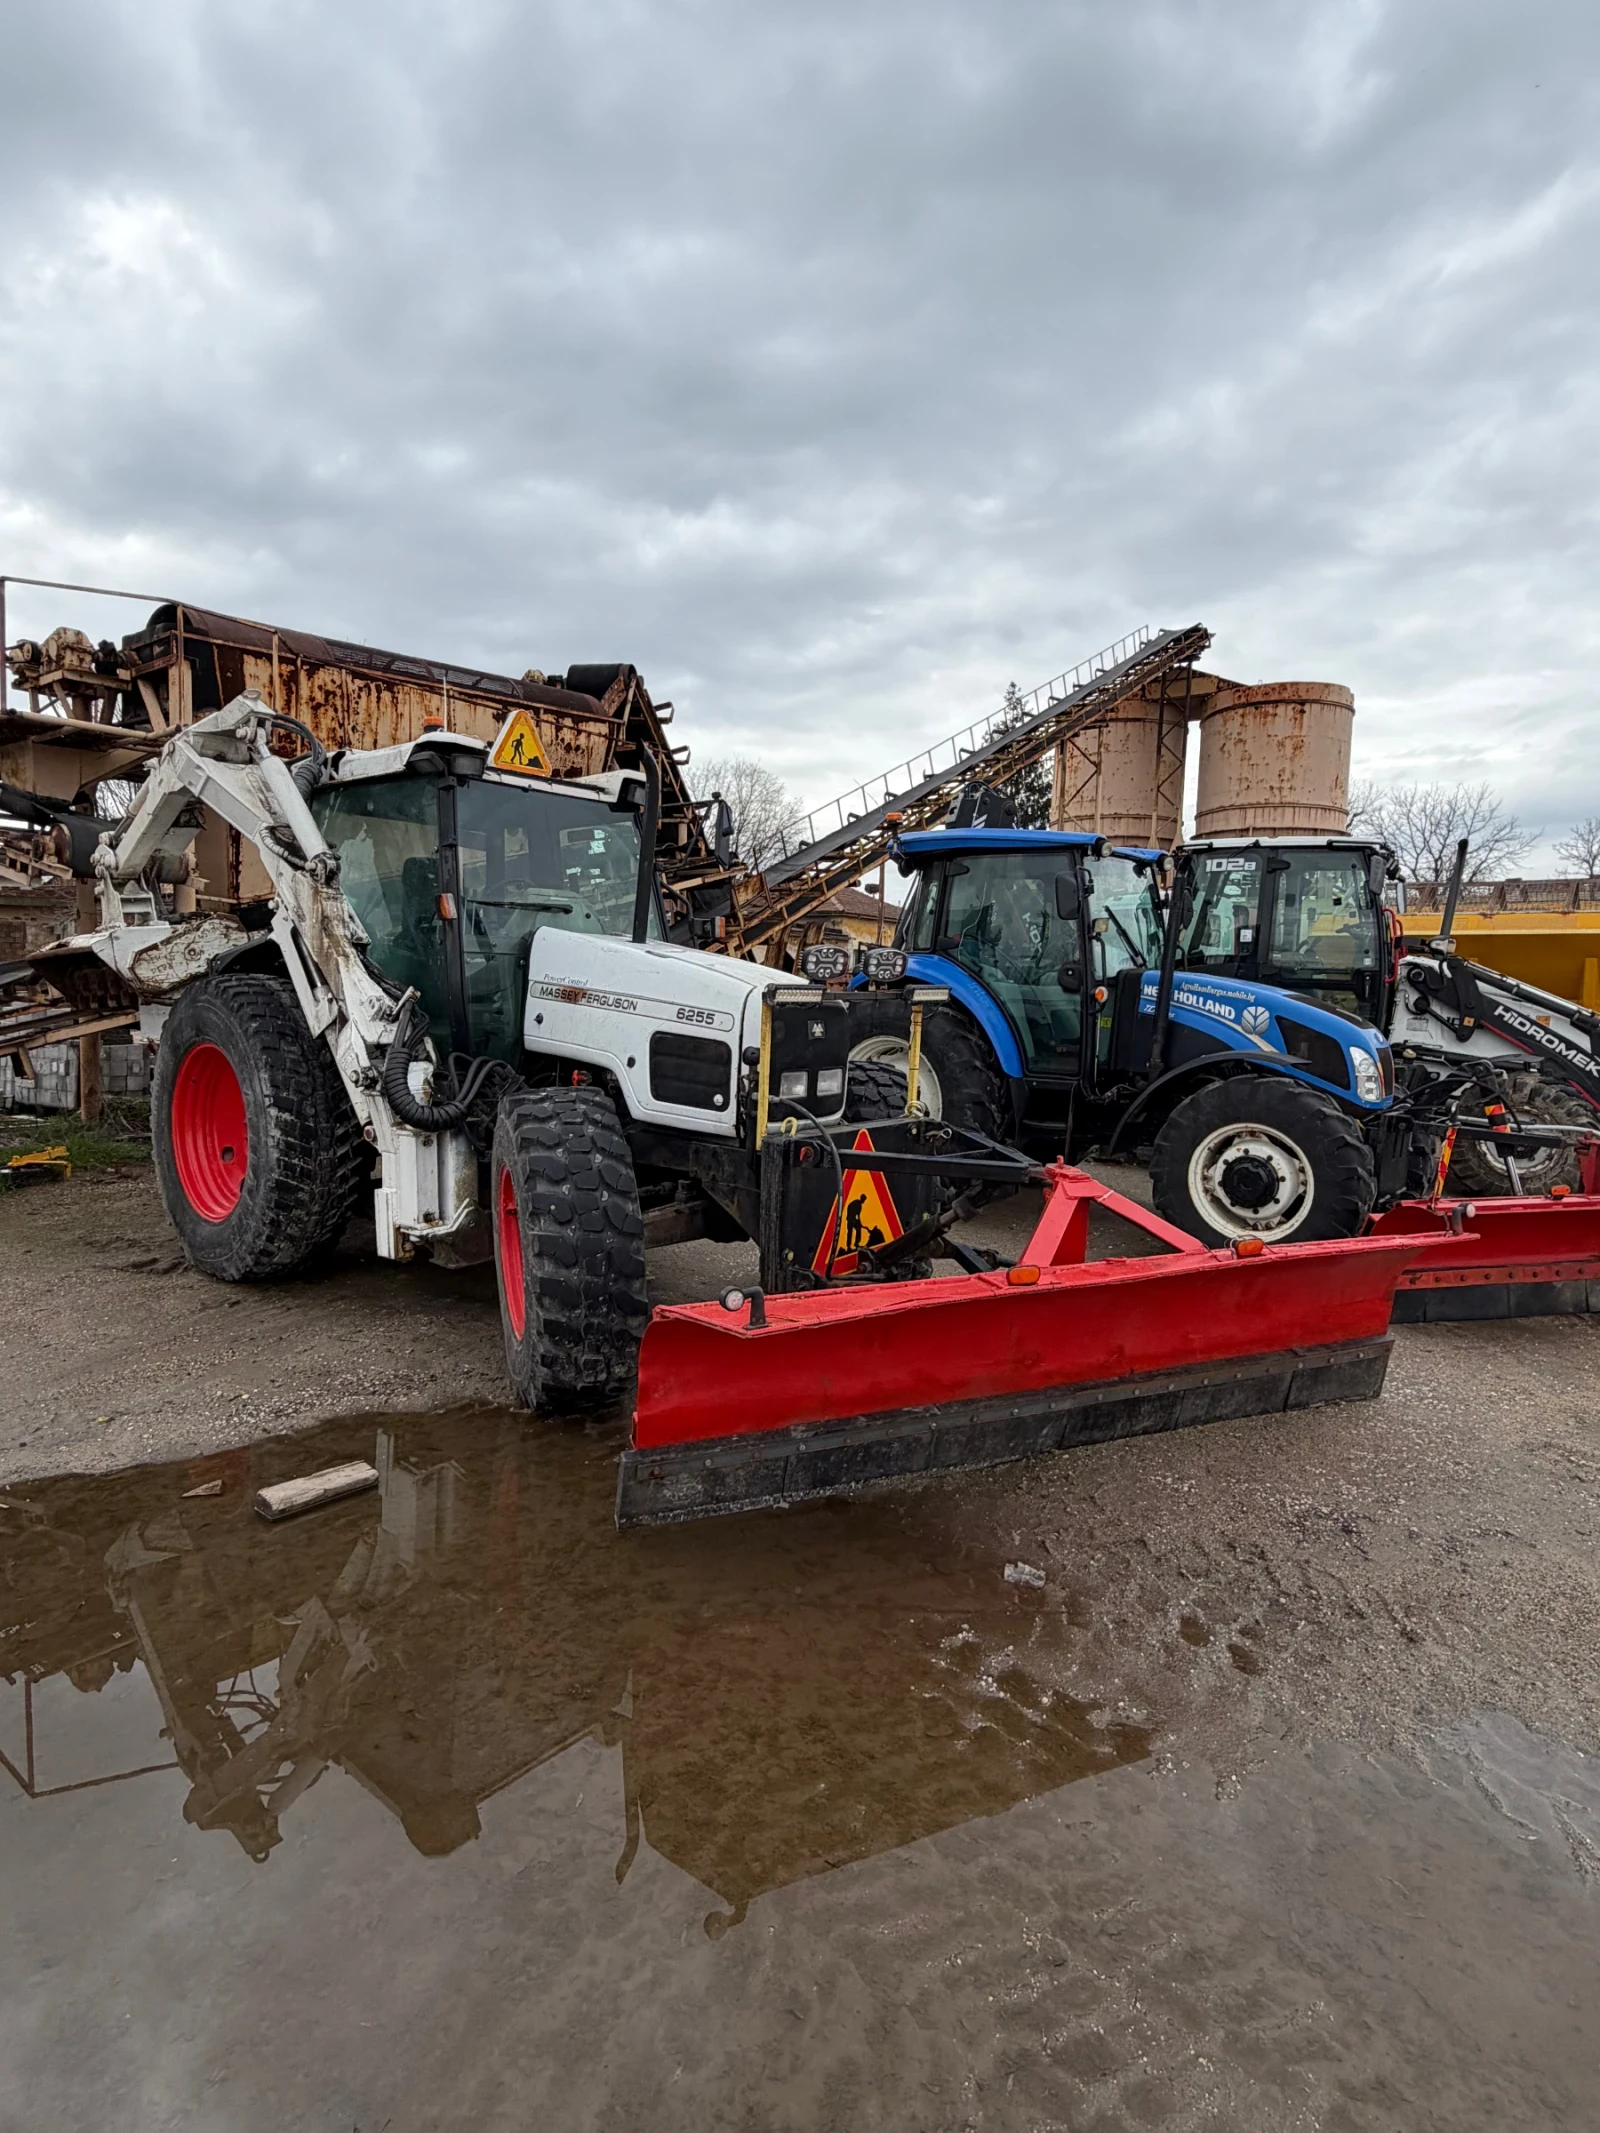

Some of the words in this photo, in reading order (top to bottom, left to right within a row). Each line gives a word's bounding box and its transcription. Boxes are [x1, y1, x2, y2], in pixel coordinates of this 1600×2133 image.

[539, 986, 580, 1003] MASSEY
[580, 992, 639, 1012] FERGUSON
[676, 1007, 716, 1026] 6255
[1143, 984, 1160, 997] NE
[1173, 989, 1236, 1020] HOLLAND
